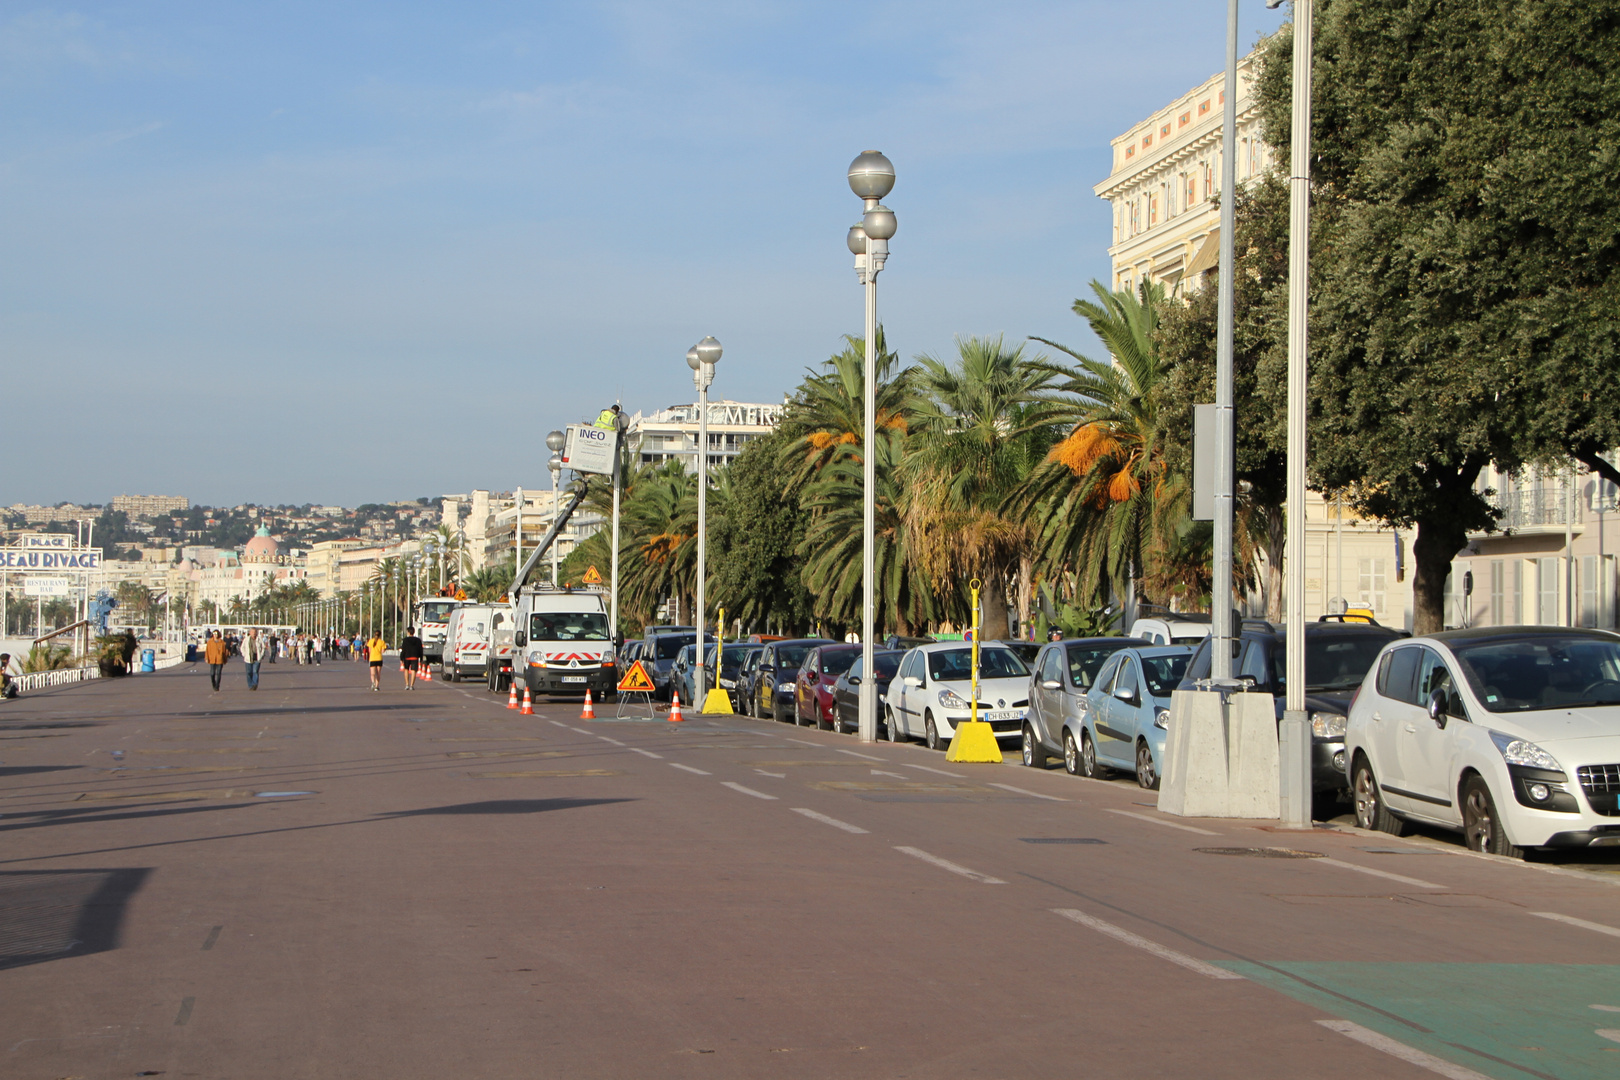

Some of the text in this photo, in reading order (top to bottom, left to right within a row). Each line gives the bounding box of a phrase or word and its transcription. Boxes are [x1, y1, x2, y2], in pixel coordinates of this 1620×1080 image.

[579, 428, 606, 441] INEO
[30, 538, 64, 546] PLAGE
[43, 553, 97, 567] RIVAGE
[247, 555, 296, 564] NEGRESCO
